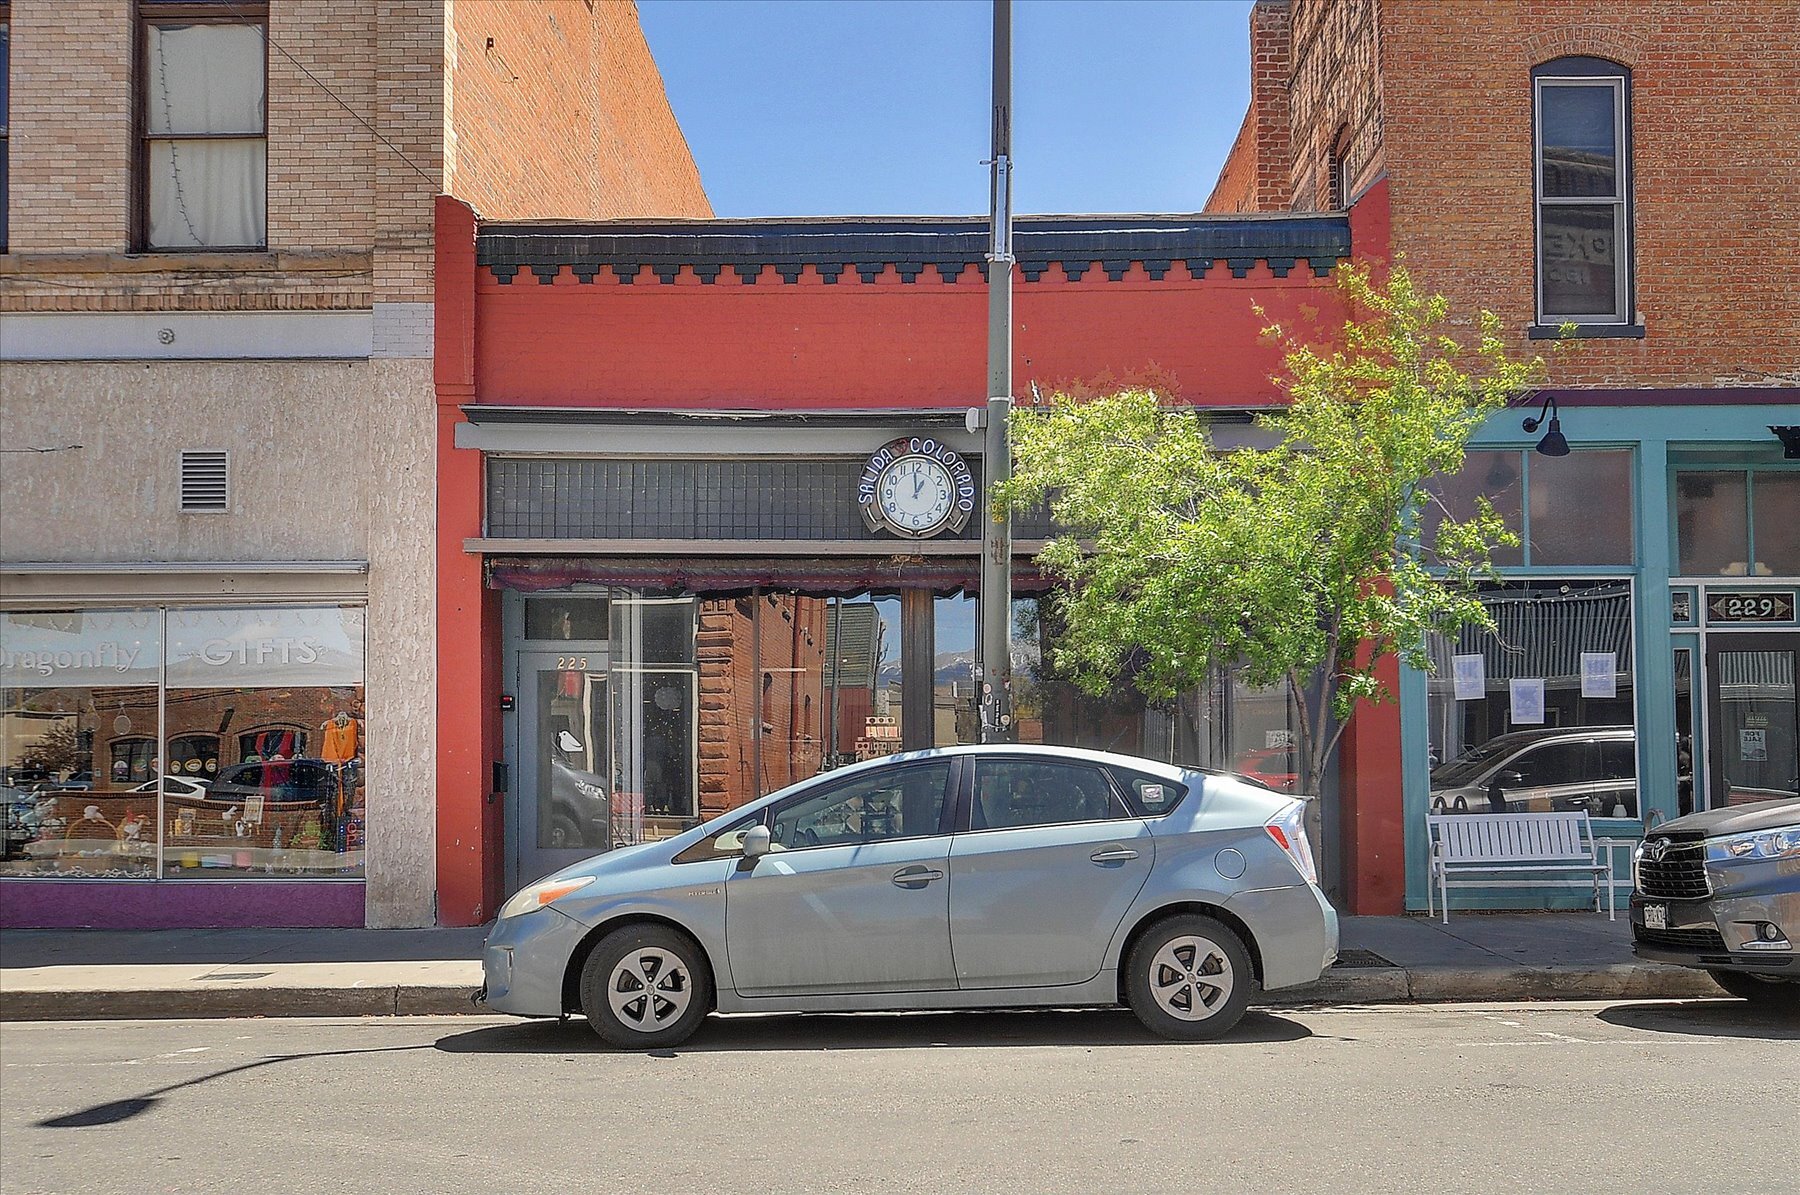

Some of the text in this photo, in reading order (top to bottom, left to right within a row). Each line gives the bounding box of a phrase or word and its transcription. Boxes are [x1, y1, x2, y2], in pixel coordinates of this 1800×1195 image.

[900, 465, 906, 475] 11
[912, 462, 922, 473] 12
[928, 466, 932, 476] 1
[858, 437, 975, 511] SALIDA COLORADO
[888, 474, 898, 486] 10
[936, 475, 943, 487] 2
[885, 488, 893, 499] 9
[939, 489, 947, 500] 3
[889, 502, 896, 513] 8
[935, 503, 942, 514] 4
[899, 512, 906, 523] 7
[912, 515, 920, 526] 6
[926, 512, 933, 523] 5
[1728, 599, 1773, 617] 229
[200, 636, 318, 666] GIFTS
[557, 656, 587, 670] 225
